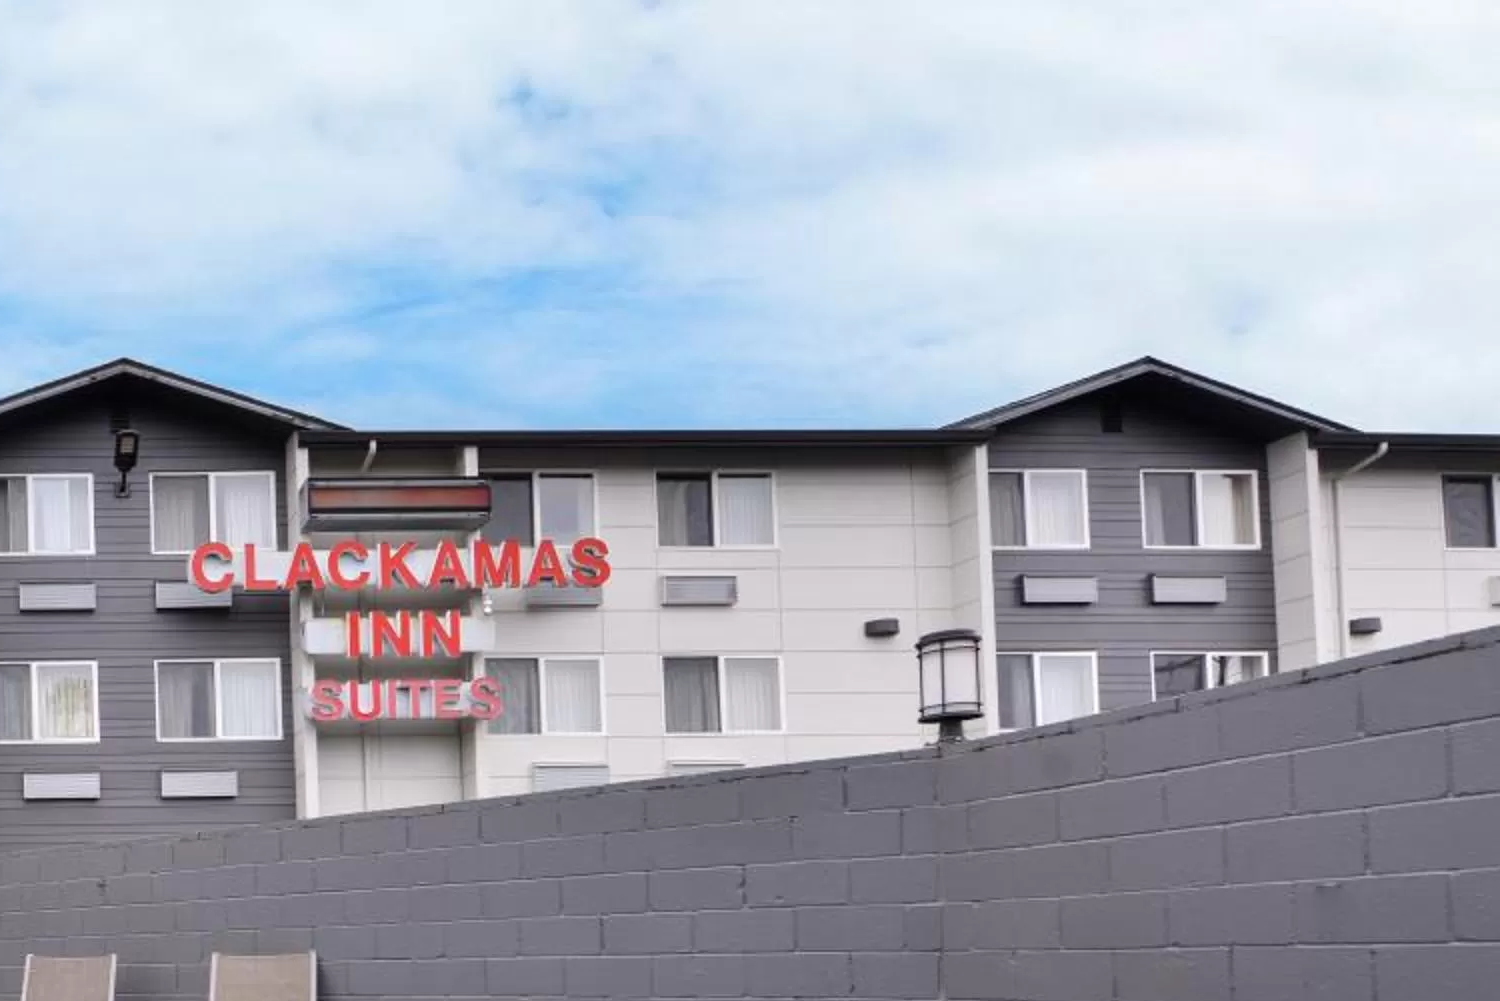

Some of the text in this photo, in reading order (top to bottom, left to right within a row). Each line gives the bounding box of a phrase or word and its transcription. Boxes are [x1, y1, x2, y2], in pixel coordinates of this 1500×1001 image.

[190, 537, 612, 594] CLACKAMAS
[346, 609, 463, 658] INN
[309, 676, 505, 721] SUITES
